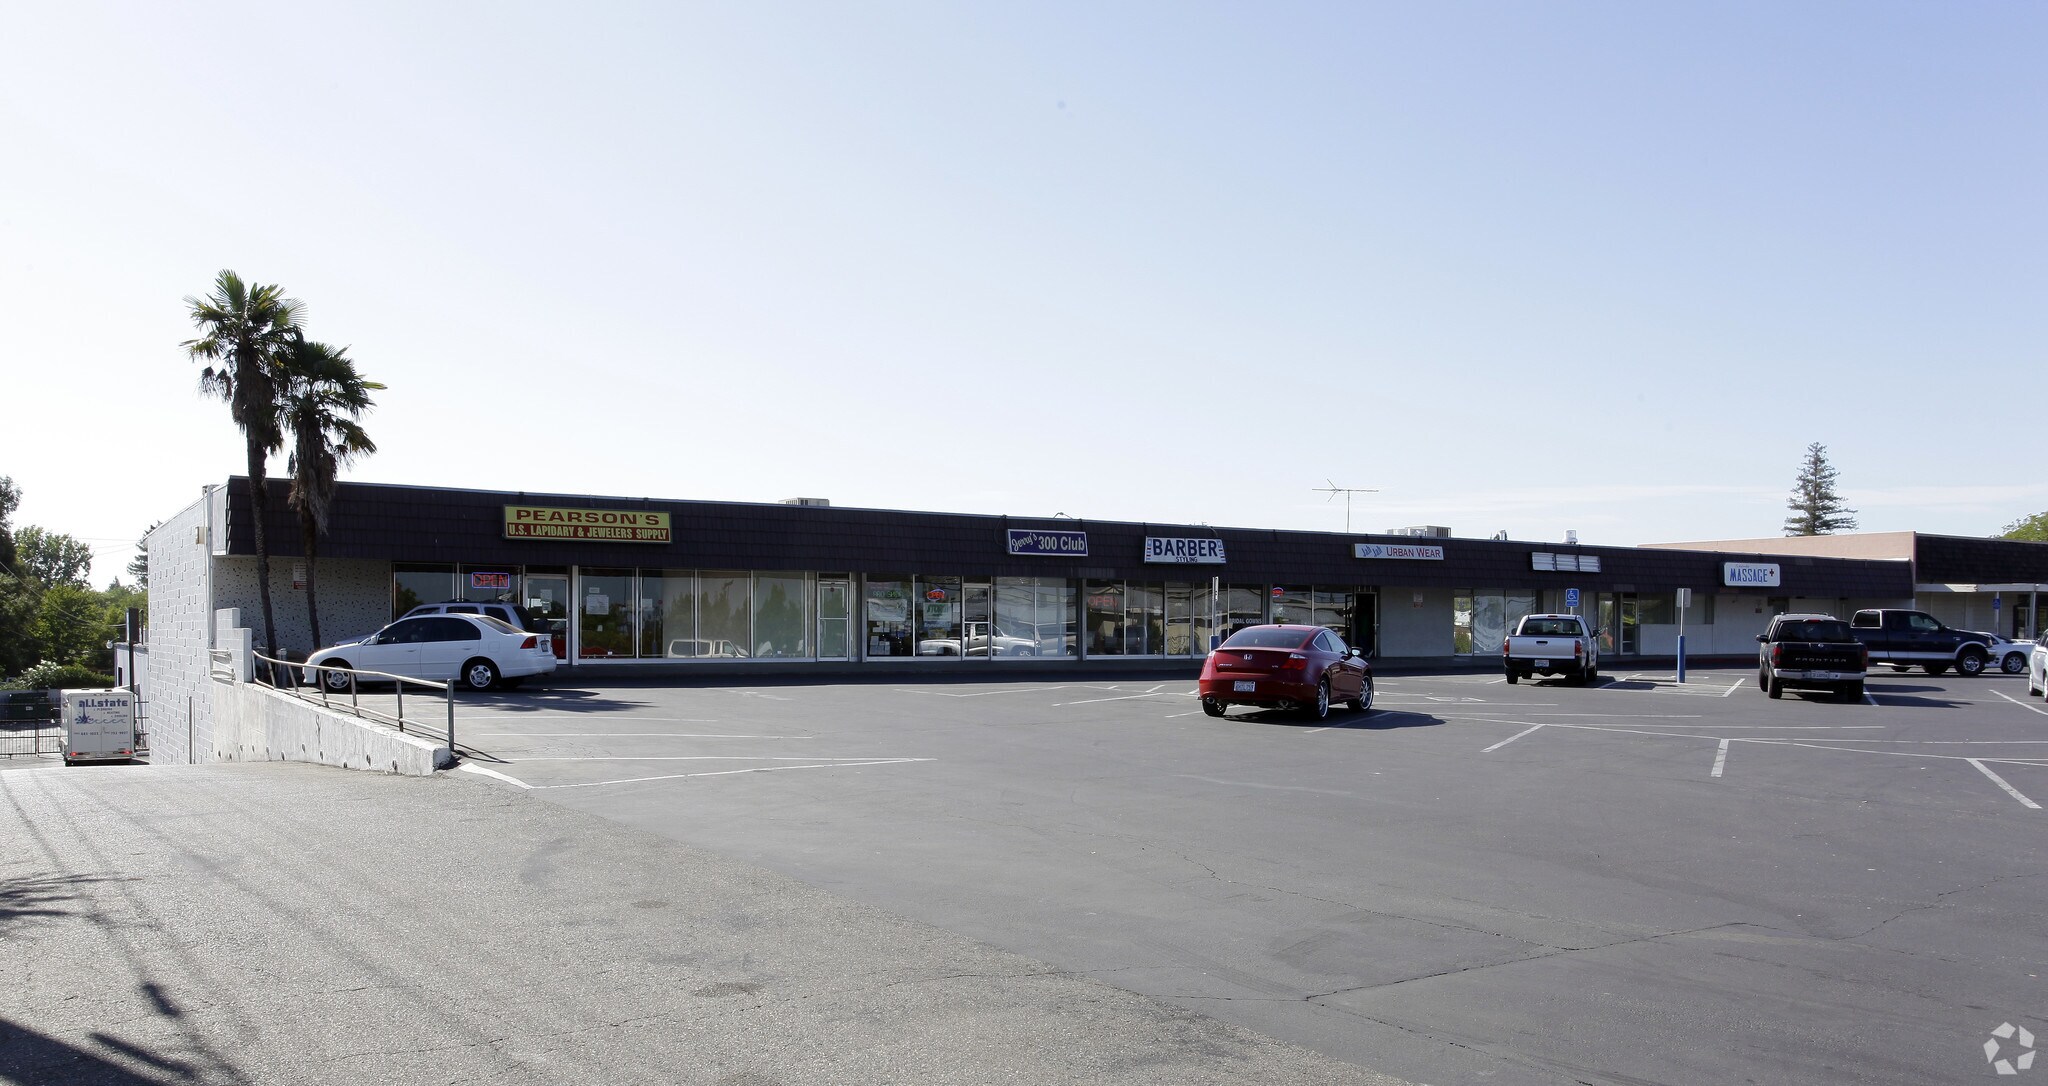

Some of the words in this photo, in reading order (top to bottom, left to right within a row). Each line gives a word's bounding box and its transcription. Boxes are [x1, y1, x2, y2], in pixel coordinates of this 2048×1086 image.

[516, 509, 660, 526] PEARSON'S
[508, 524, 528, 536] U.S.
[530, 525, 575, 537] LAPIDARY
[577, 526, 585, 538] &
[587, 527, 633, 539] JEWELERS
[635, 528, 668, 540] SUPPLY
[1011, 532, 1038, 552] Jerry's
[1038, 536, 1058, 550] 300
[1060, 536, 1085, 551] Club
[1152, 538, 1218, 557] BARBER
[473, 574, 508, 587] OPEN
[1729, 567, 1768, 583] MASSAGE
